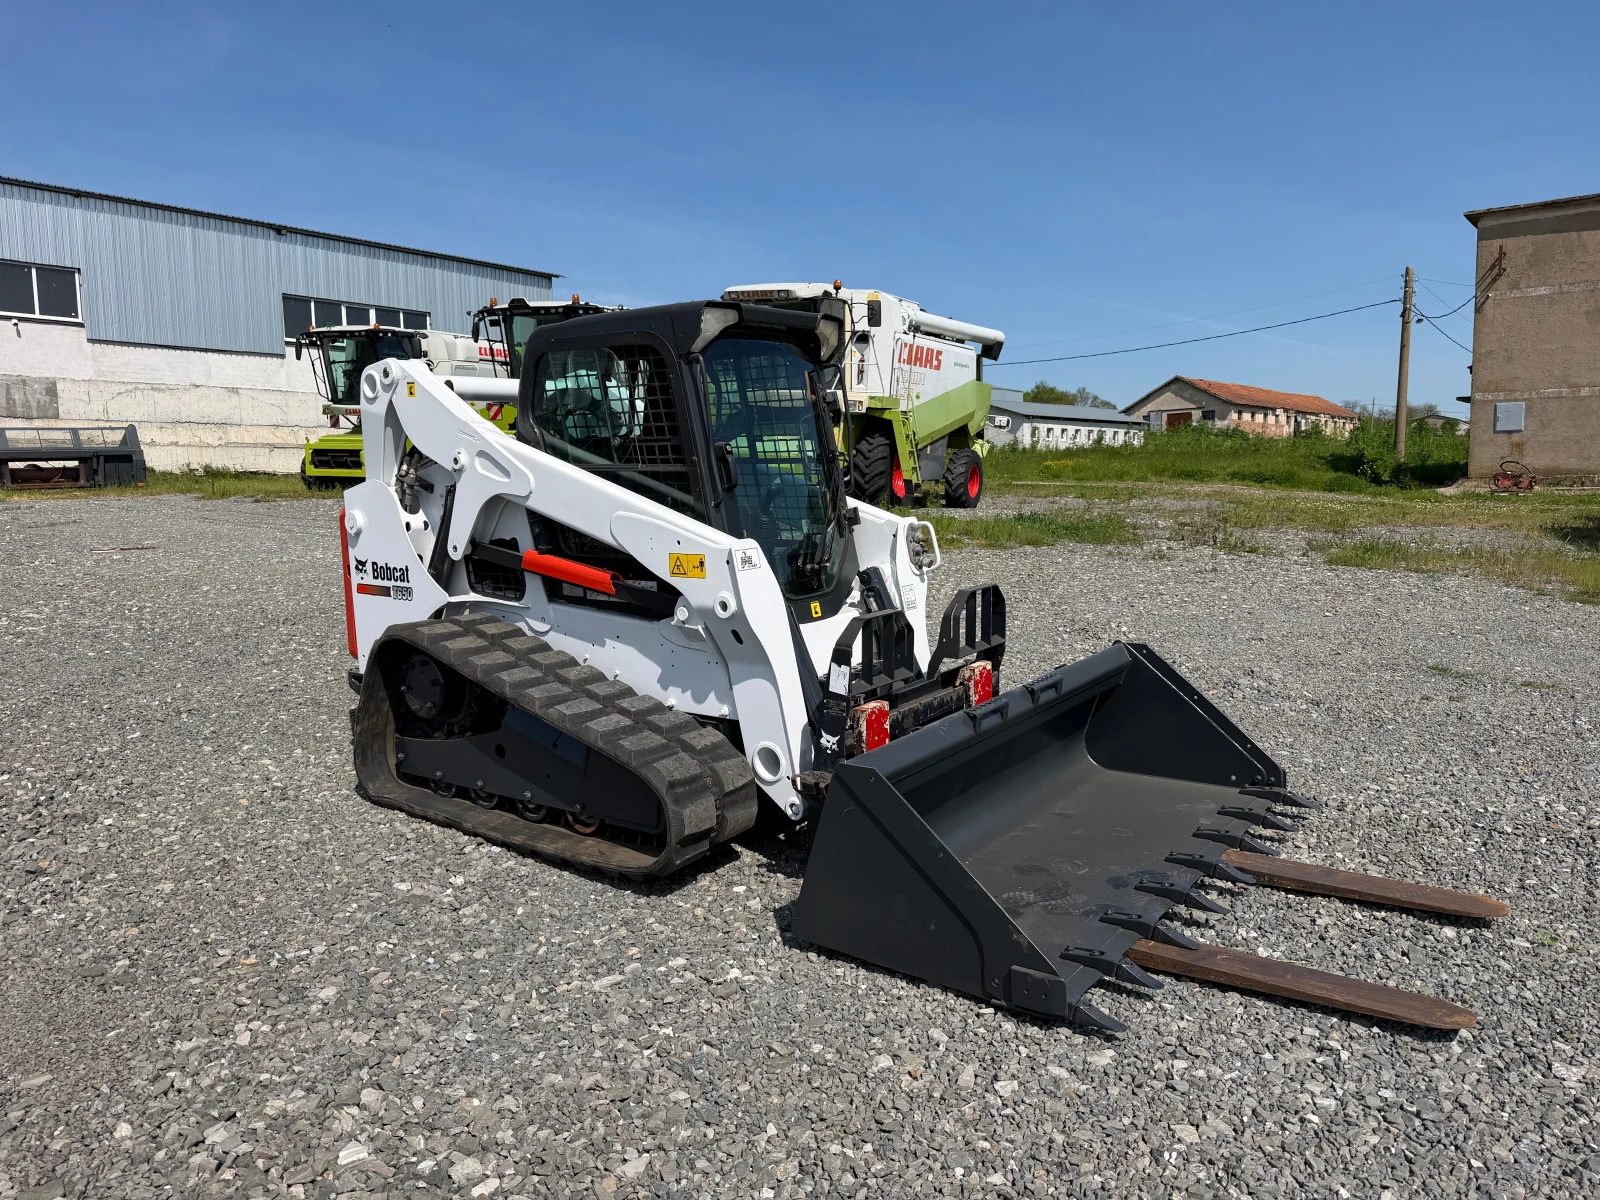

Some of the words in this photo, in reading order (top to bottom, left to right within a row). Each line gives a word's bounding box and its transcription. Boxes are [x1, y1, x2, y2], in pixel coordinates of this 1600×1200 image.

[741, 290, 775, 298] CLAAS
[897, 342, 943, 371] CLAAS
[371, 561, 410, 584] Bobcat
[391, 585, 414, 602] T650
